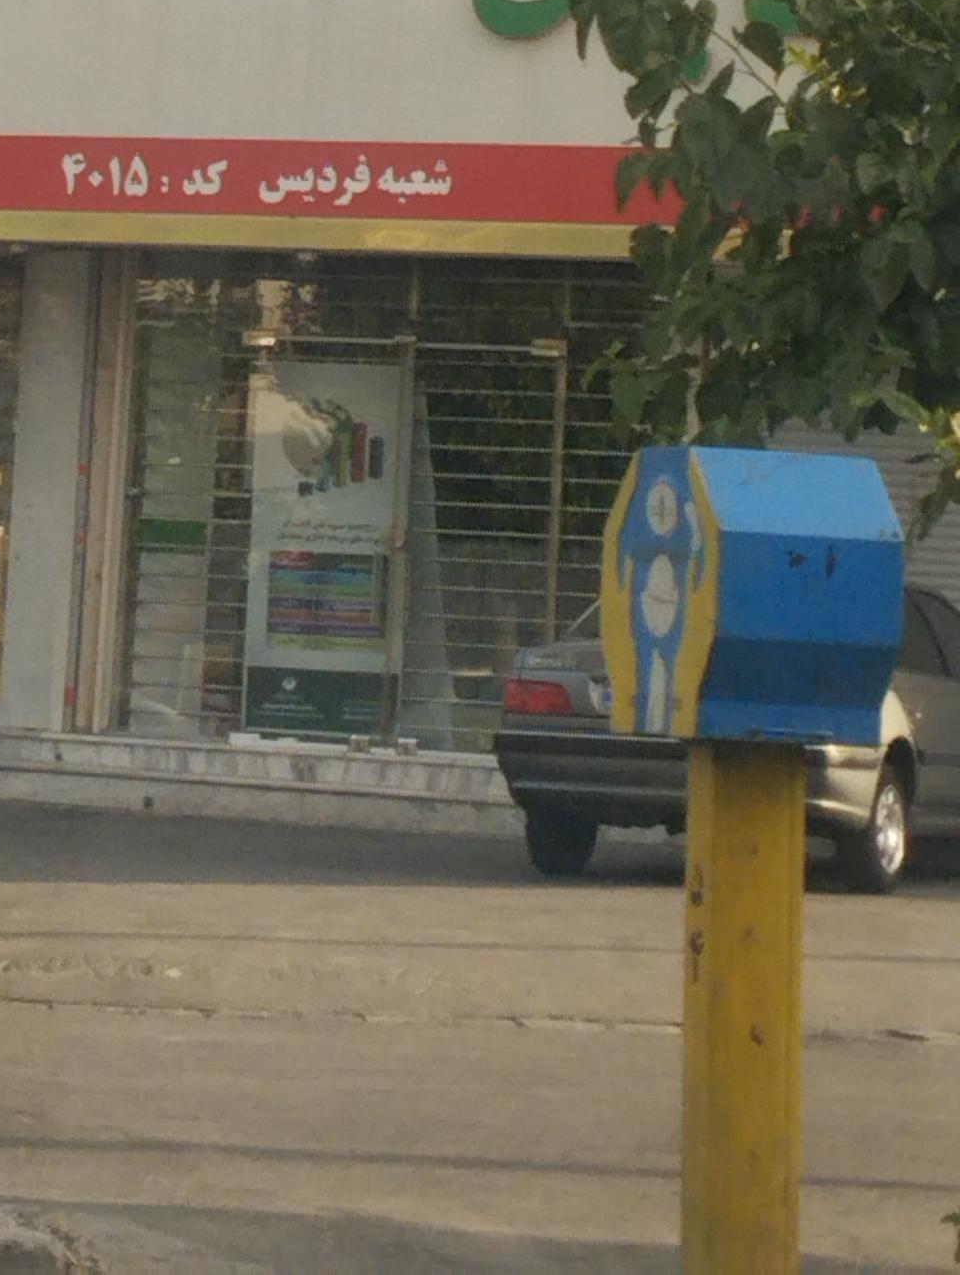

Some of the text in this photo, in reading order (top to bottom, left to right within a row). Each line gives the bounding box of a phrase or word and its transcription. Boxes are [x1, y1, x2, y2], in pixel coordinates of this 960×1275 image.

[62, 152, 149, 197] ۴۰۱۵
[259, 153, 371, 206] فردیس
[377, 159, 452, 204] شعبه
